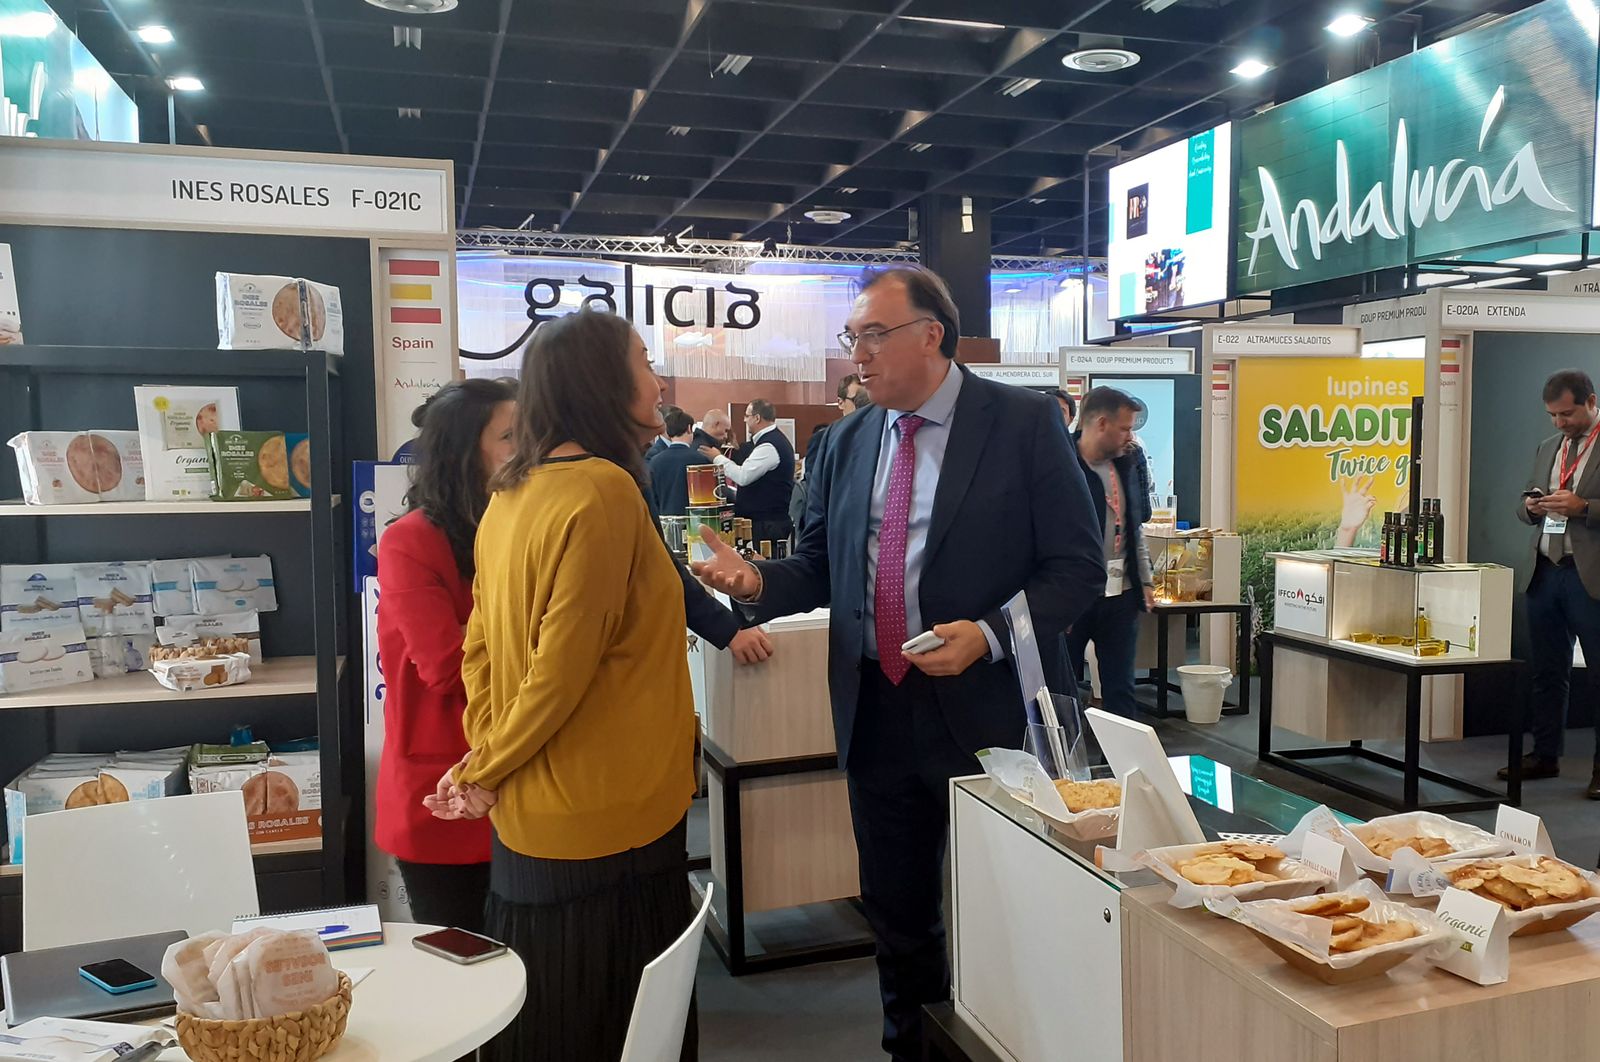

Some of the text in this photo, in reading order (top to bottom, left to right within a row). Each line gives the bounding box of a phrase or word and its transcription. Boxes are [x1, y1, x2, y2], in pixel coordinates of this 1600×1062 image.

[1246, 84, 1575, 277] Andalucía
[172, 179, 421, 211] INES ROSALES F-021C
[1378, 310, 1404, 321] PREMIUM
[1405, 306, 1427, 317] PRODU
[1447, 305, 1526, 316] E-020A EXTENDA
[392, 336, 434, 351] Spain
[1218, 335, 1332, 345] E-022 ALTRAMUCES SALADITOS
[1114, 356, 1142, 365] PREMIUM
[1143, 357, 1174, 365] PRODUCTS
[1327, 376, 1409, 399] lupines
[1261, 406, 1411, 446] SALADIT
[1326, 447, 1411, 487] Twice g
[1278, 589, 1296, 599] IFFCO
[1500, 830, 1532, 848] CINNAMON
[1438, 910, 1488, 938] Organic
